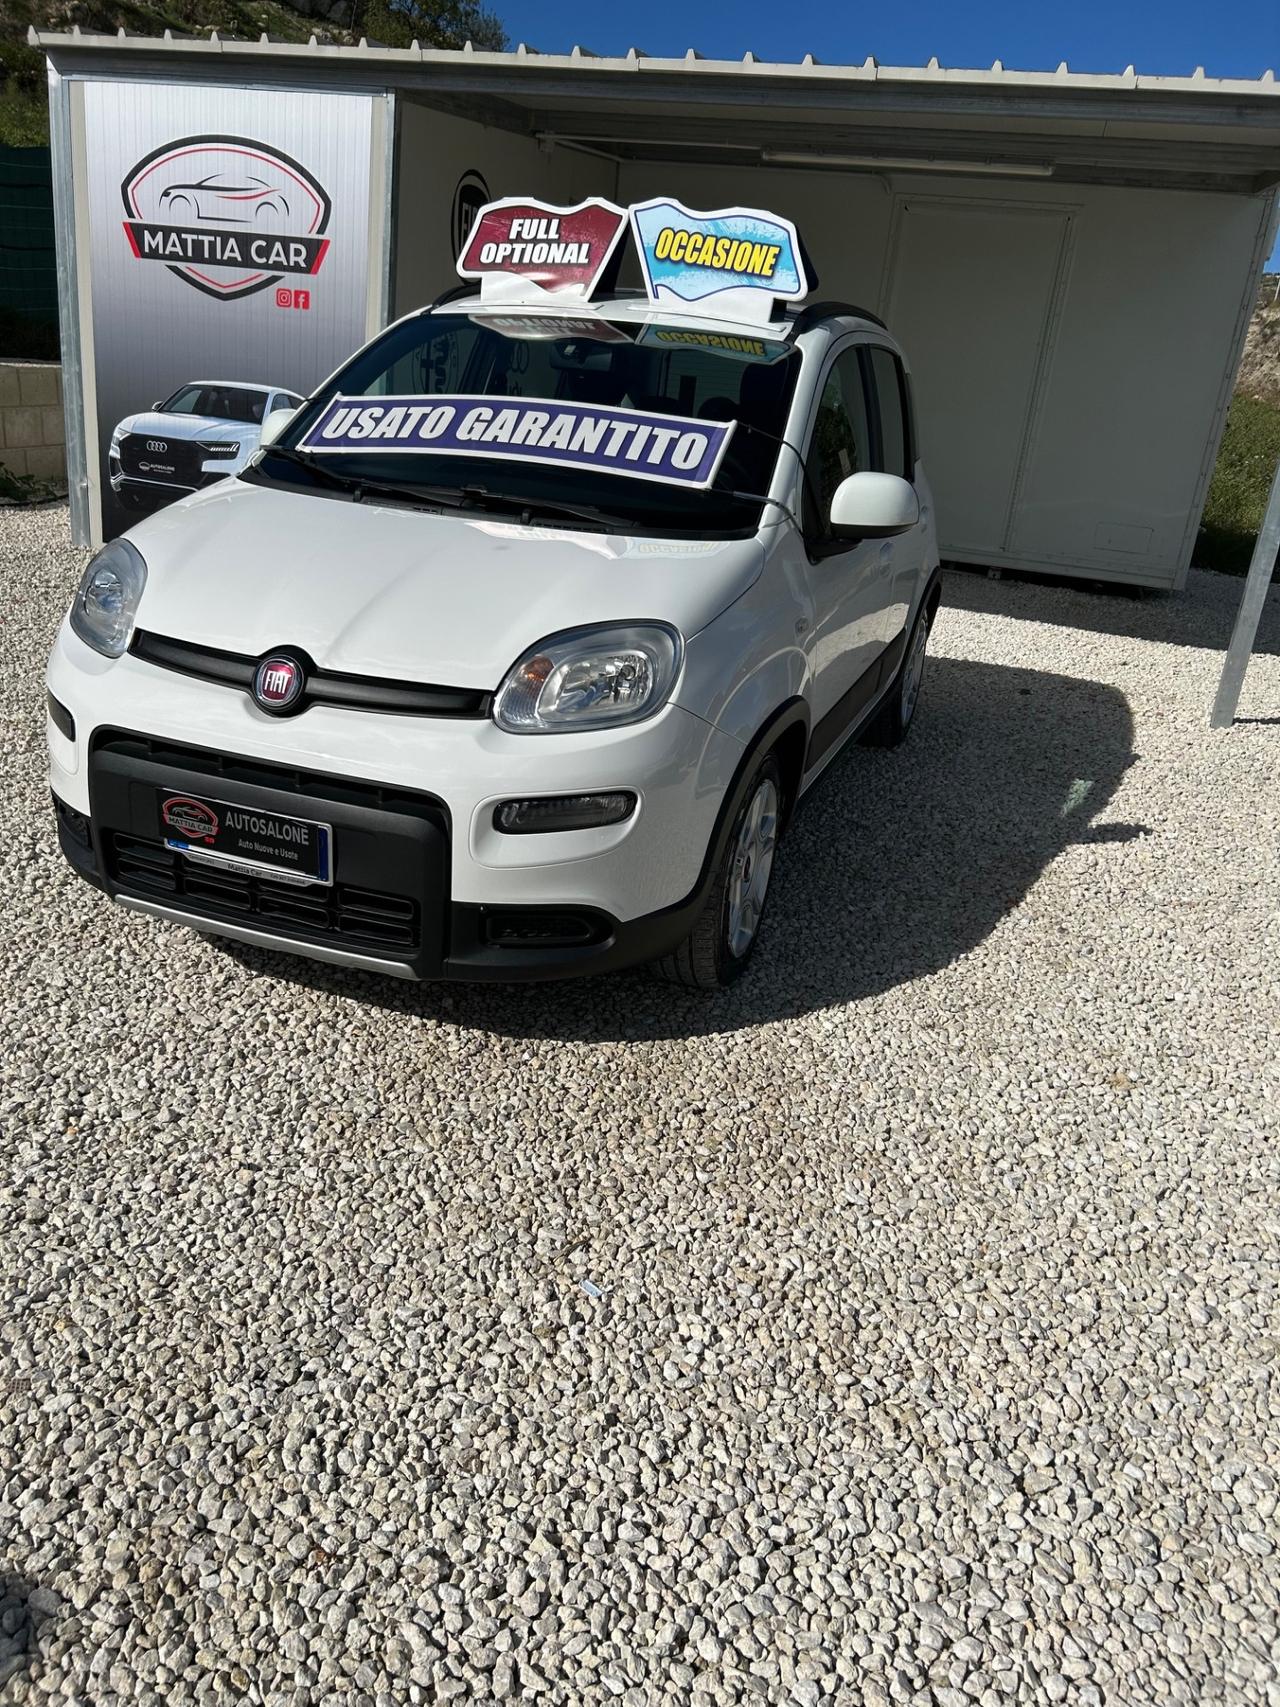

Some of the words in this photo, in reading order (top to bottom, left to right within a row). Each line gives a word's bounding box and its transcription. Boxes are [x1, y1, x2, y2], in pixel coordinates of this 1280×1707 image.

[509, 218, 560, 240] FULL
[144, 229, 243, 263] MATTIA
[251, 240, 307, 268] CAR
[480, 242, 589, 264] OPTIONAL
[655, 228, 780, 277] OCCASIONE
[322, 405, 457, 441] USATO
[456, 405, 709, 470] GARANTITO
[264, 670, 291, 694] FIAT
[169, 816, 196, 828] MATTIA
[197, 824, 213, 833] CAR
[225, 811, 309, 846] AUTOSALONE
[238, 839, 254, 850] Auto
[254, 842, 273, 855] Nuove
[280, 847, 298, 860] Usate
[228, 863, 249, 875] Mattia
[251, 868, 262, 876] Car
